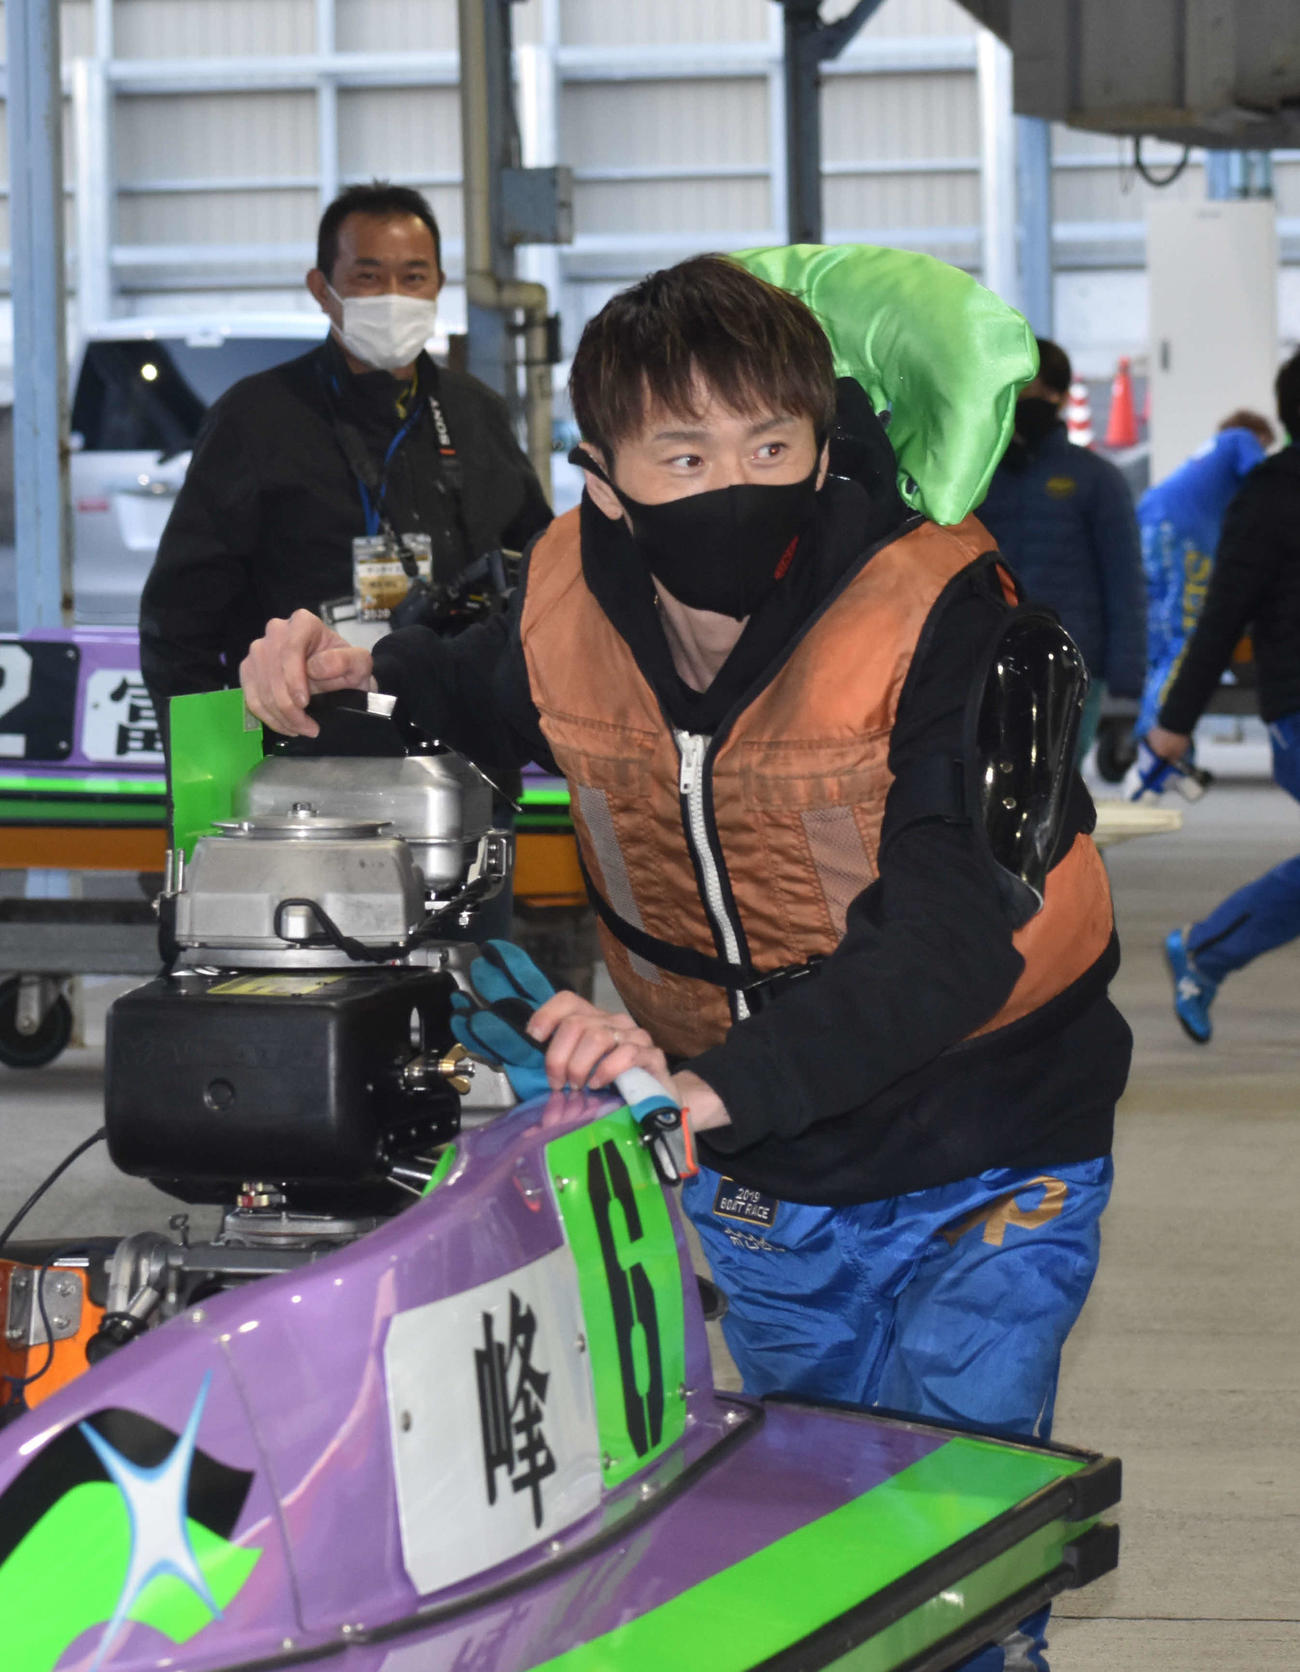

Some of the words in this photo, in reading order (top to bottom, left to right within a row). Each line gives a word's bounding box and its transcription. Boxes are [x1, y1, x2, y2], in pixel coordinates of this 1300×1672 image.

[719, 1197, 746, 1213] BOAT
[744, 1203, 771, 1220] RACE
[587, 1139, 665, 1459] 6
